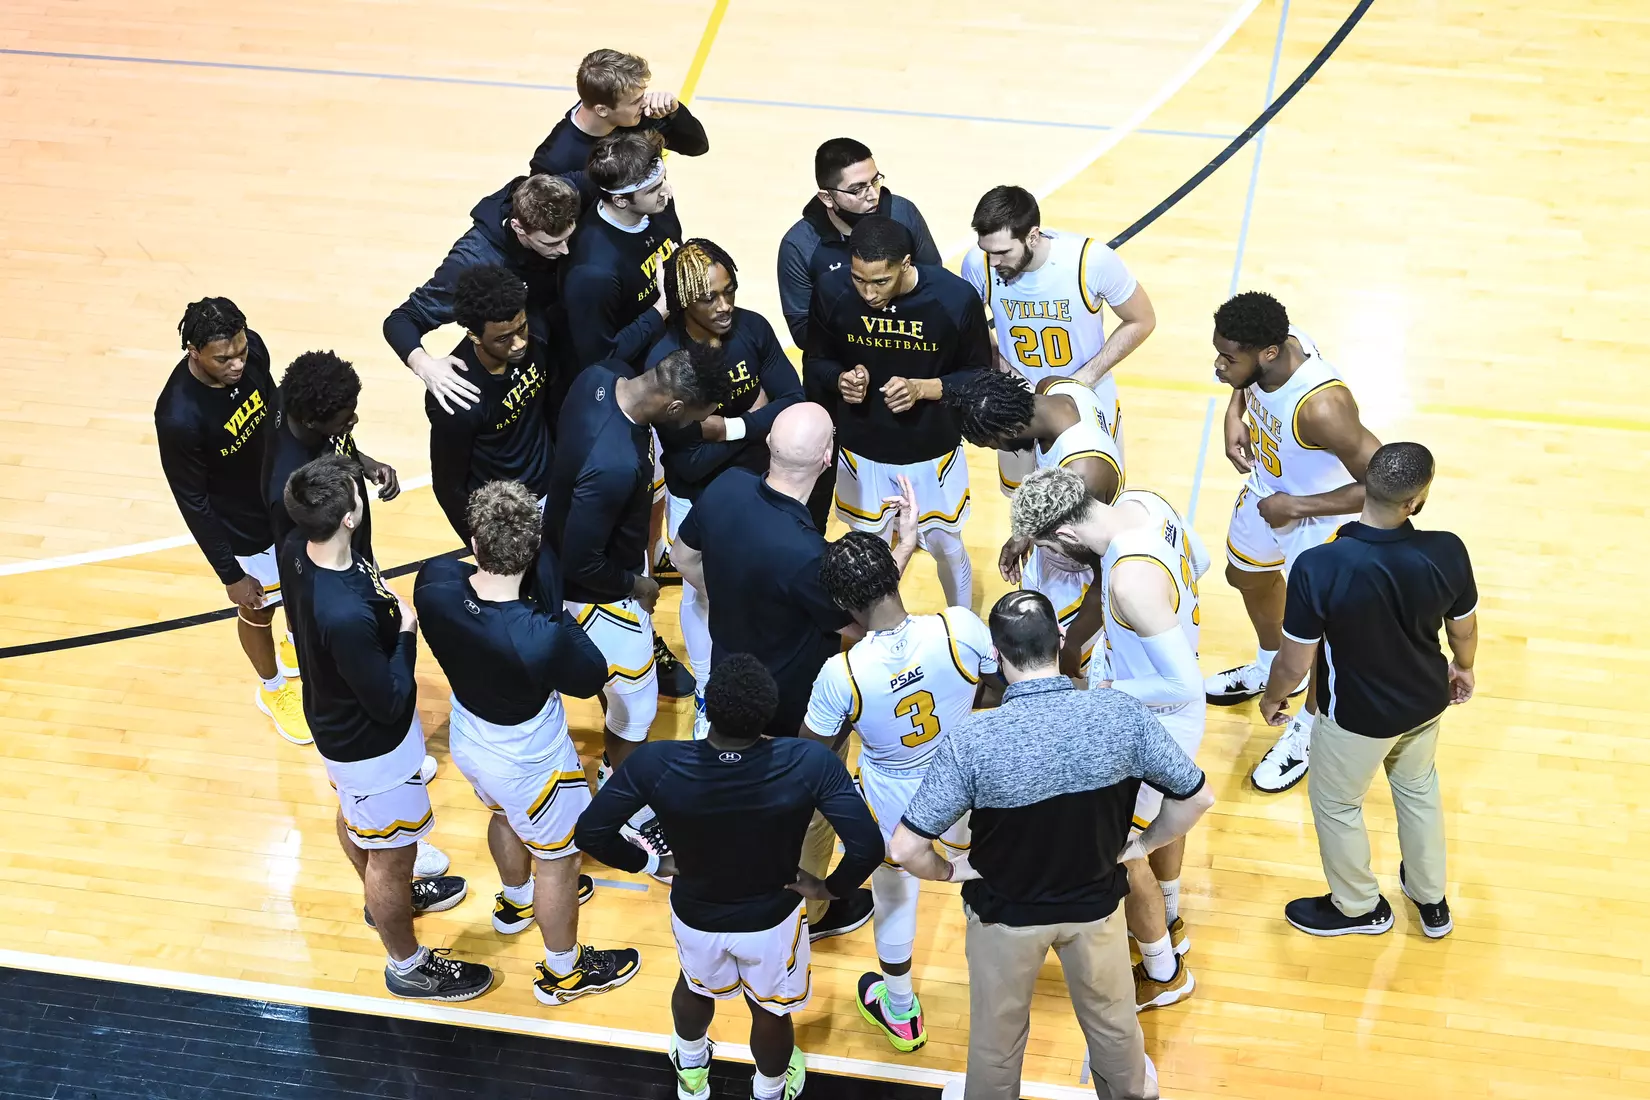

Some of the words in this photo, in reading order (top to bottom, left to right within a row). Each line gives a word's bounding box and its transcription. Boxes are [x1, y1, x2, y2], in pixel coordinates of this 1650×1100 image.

[1000, 298, 1072, 322] VILLE
[861, 316, 924, 340] VILLE
[847, 334, 940, 352] BASKETBALL
[1009, 326, 1073, 367] 20
[502, 362, 539, 410] VILLE
[224, 389, 264, 437] VILLE
[1165, 519, 1174, 545] PSAC
[890, 666, 924, 689] PSAC
[894, 689, 942, 748] 3
